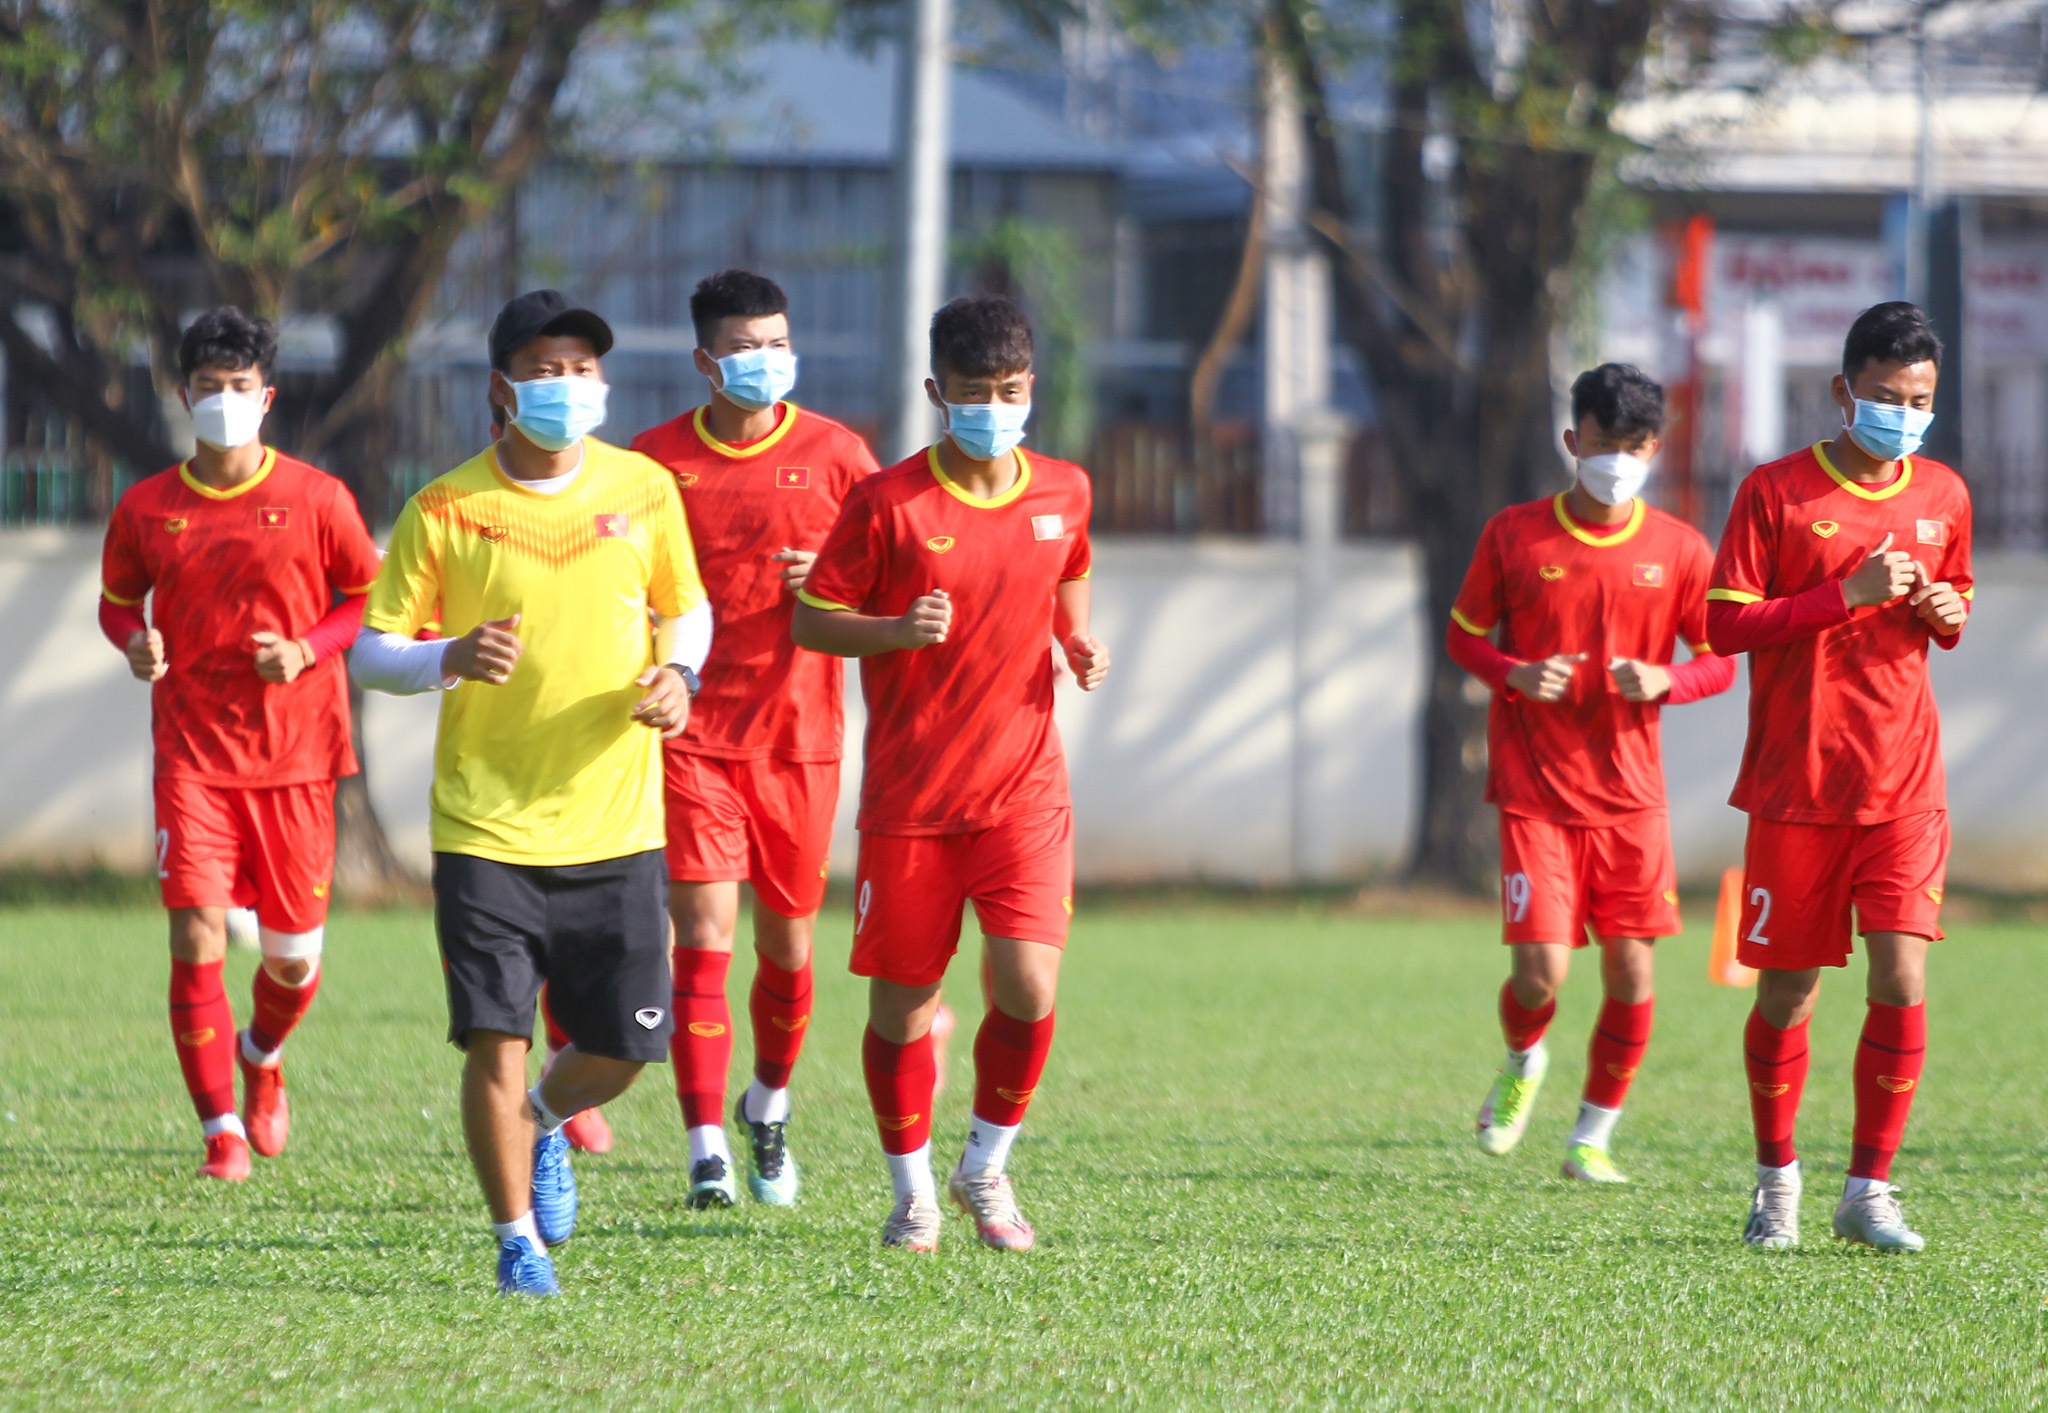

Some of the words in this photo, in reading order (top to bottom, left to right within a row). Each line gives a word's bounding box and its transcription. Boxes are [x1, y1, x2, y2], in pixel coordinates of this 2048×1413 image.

[157, 828, 169, 878] 2
[856, 880, 871, 935] 9
[1742, 884, 1771, 946] 2
